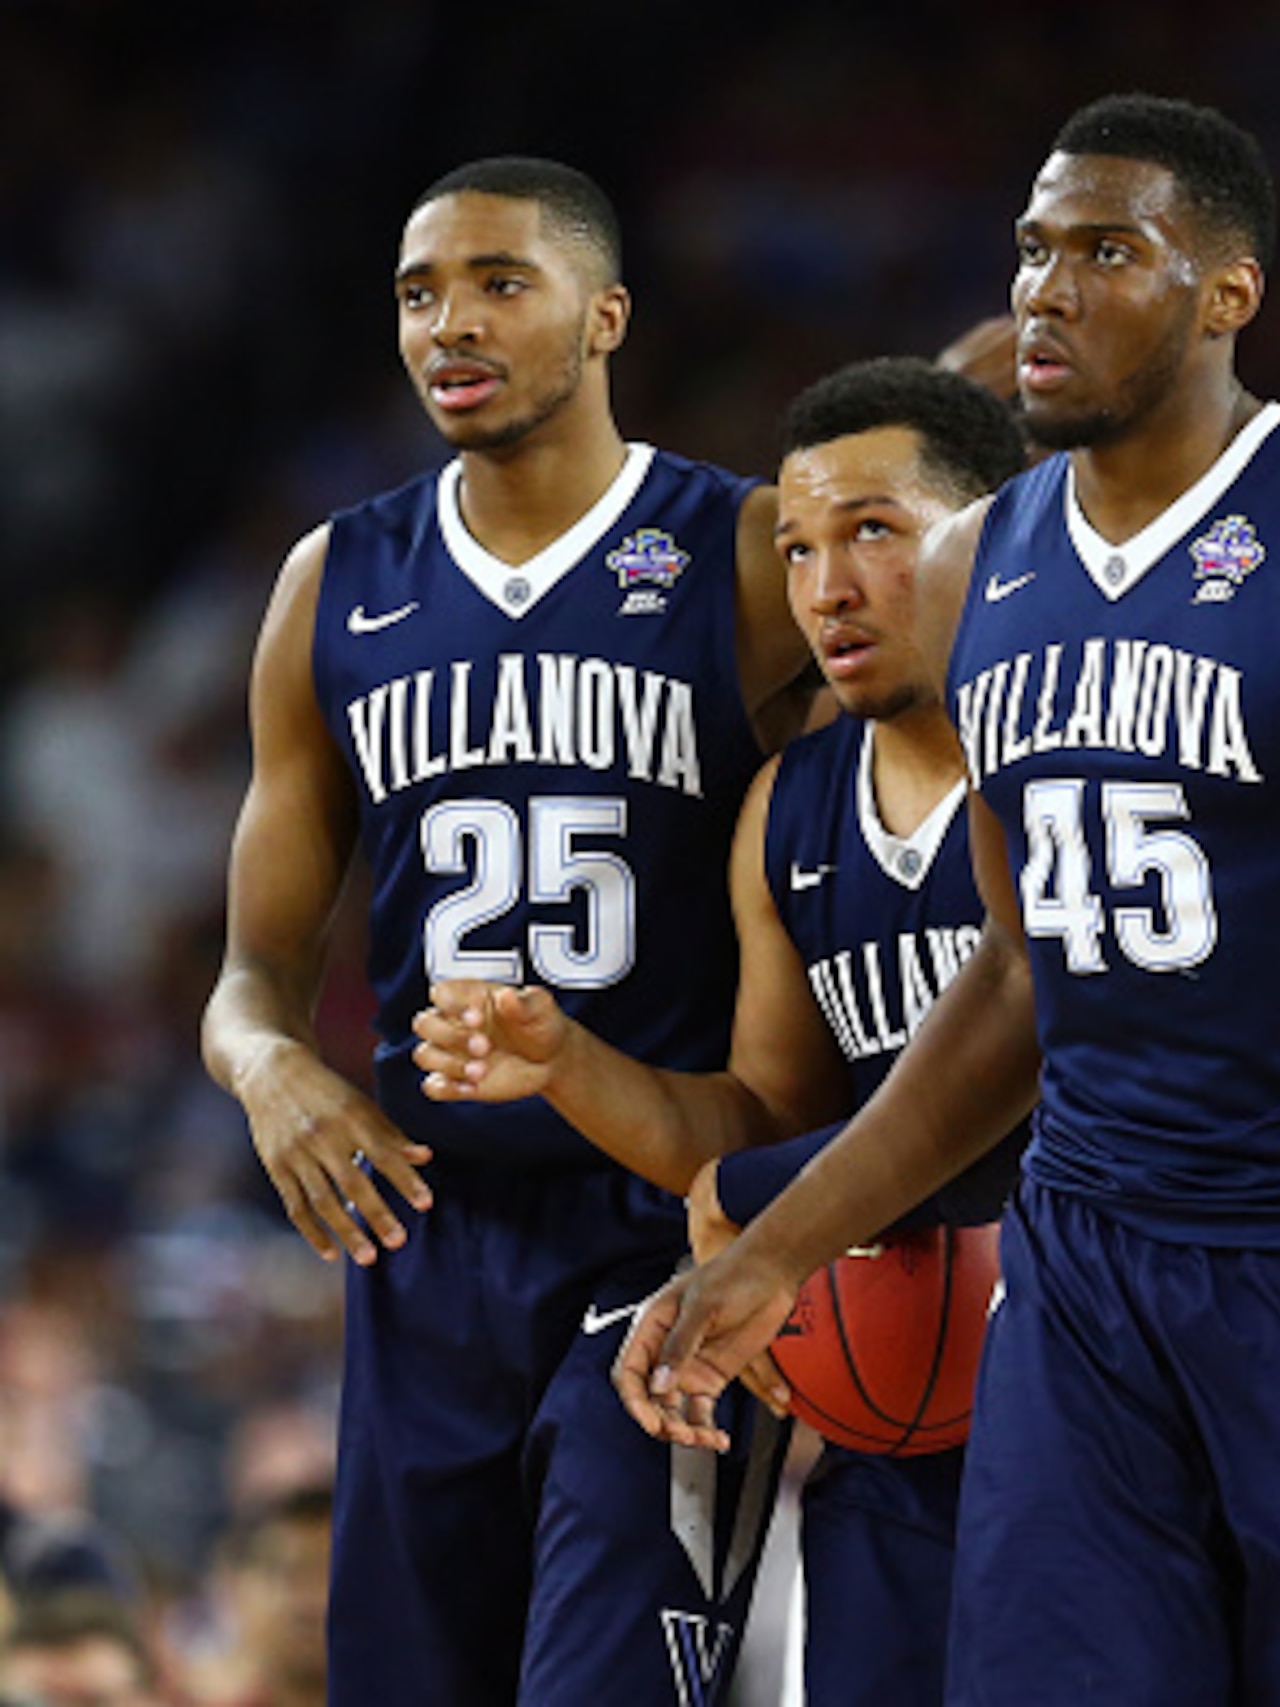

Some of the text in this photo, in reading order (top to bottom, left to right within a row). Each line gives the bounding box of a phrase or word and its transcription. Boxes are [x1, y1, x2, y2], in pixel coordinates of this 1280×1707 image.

[346, 652, 704, 804] VILLANOVA
[957, 637, 1264, 791] VILLANOVA
[419, 794, 637, 990] 25
[1019, 777, 1219, 975] 45
